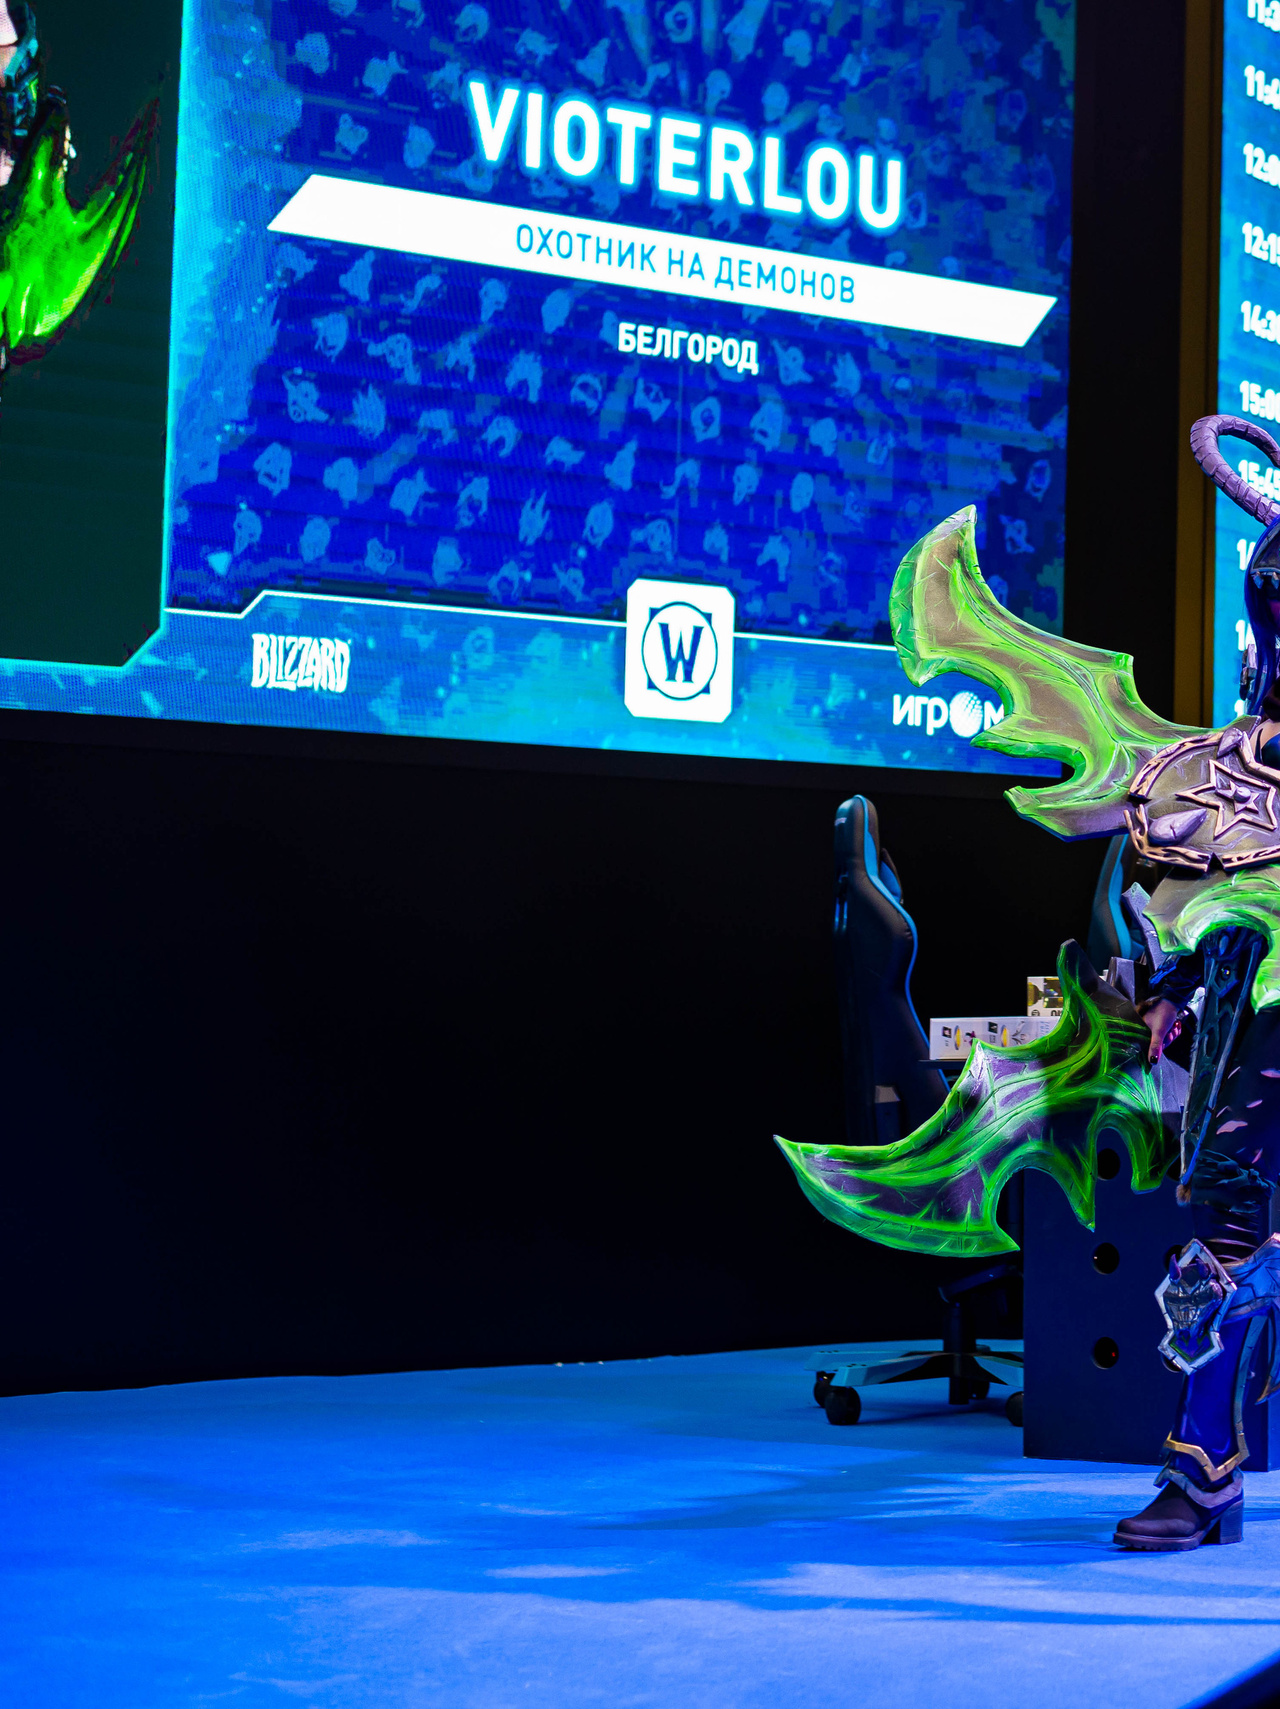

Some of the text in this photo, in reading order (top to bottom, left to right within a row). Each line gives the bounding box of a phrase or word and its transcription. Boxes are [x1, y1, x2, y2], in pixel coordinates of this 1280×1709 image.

[469, 81, 904, 229] VIOTERLOU
[516, 223, 856, 304] ОХОТНИК НА ДЕМОНОВ
[618, 322, 759, 376] БЕЛГОРОД
[251, 633, 352, 693] BLIZZARD
